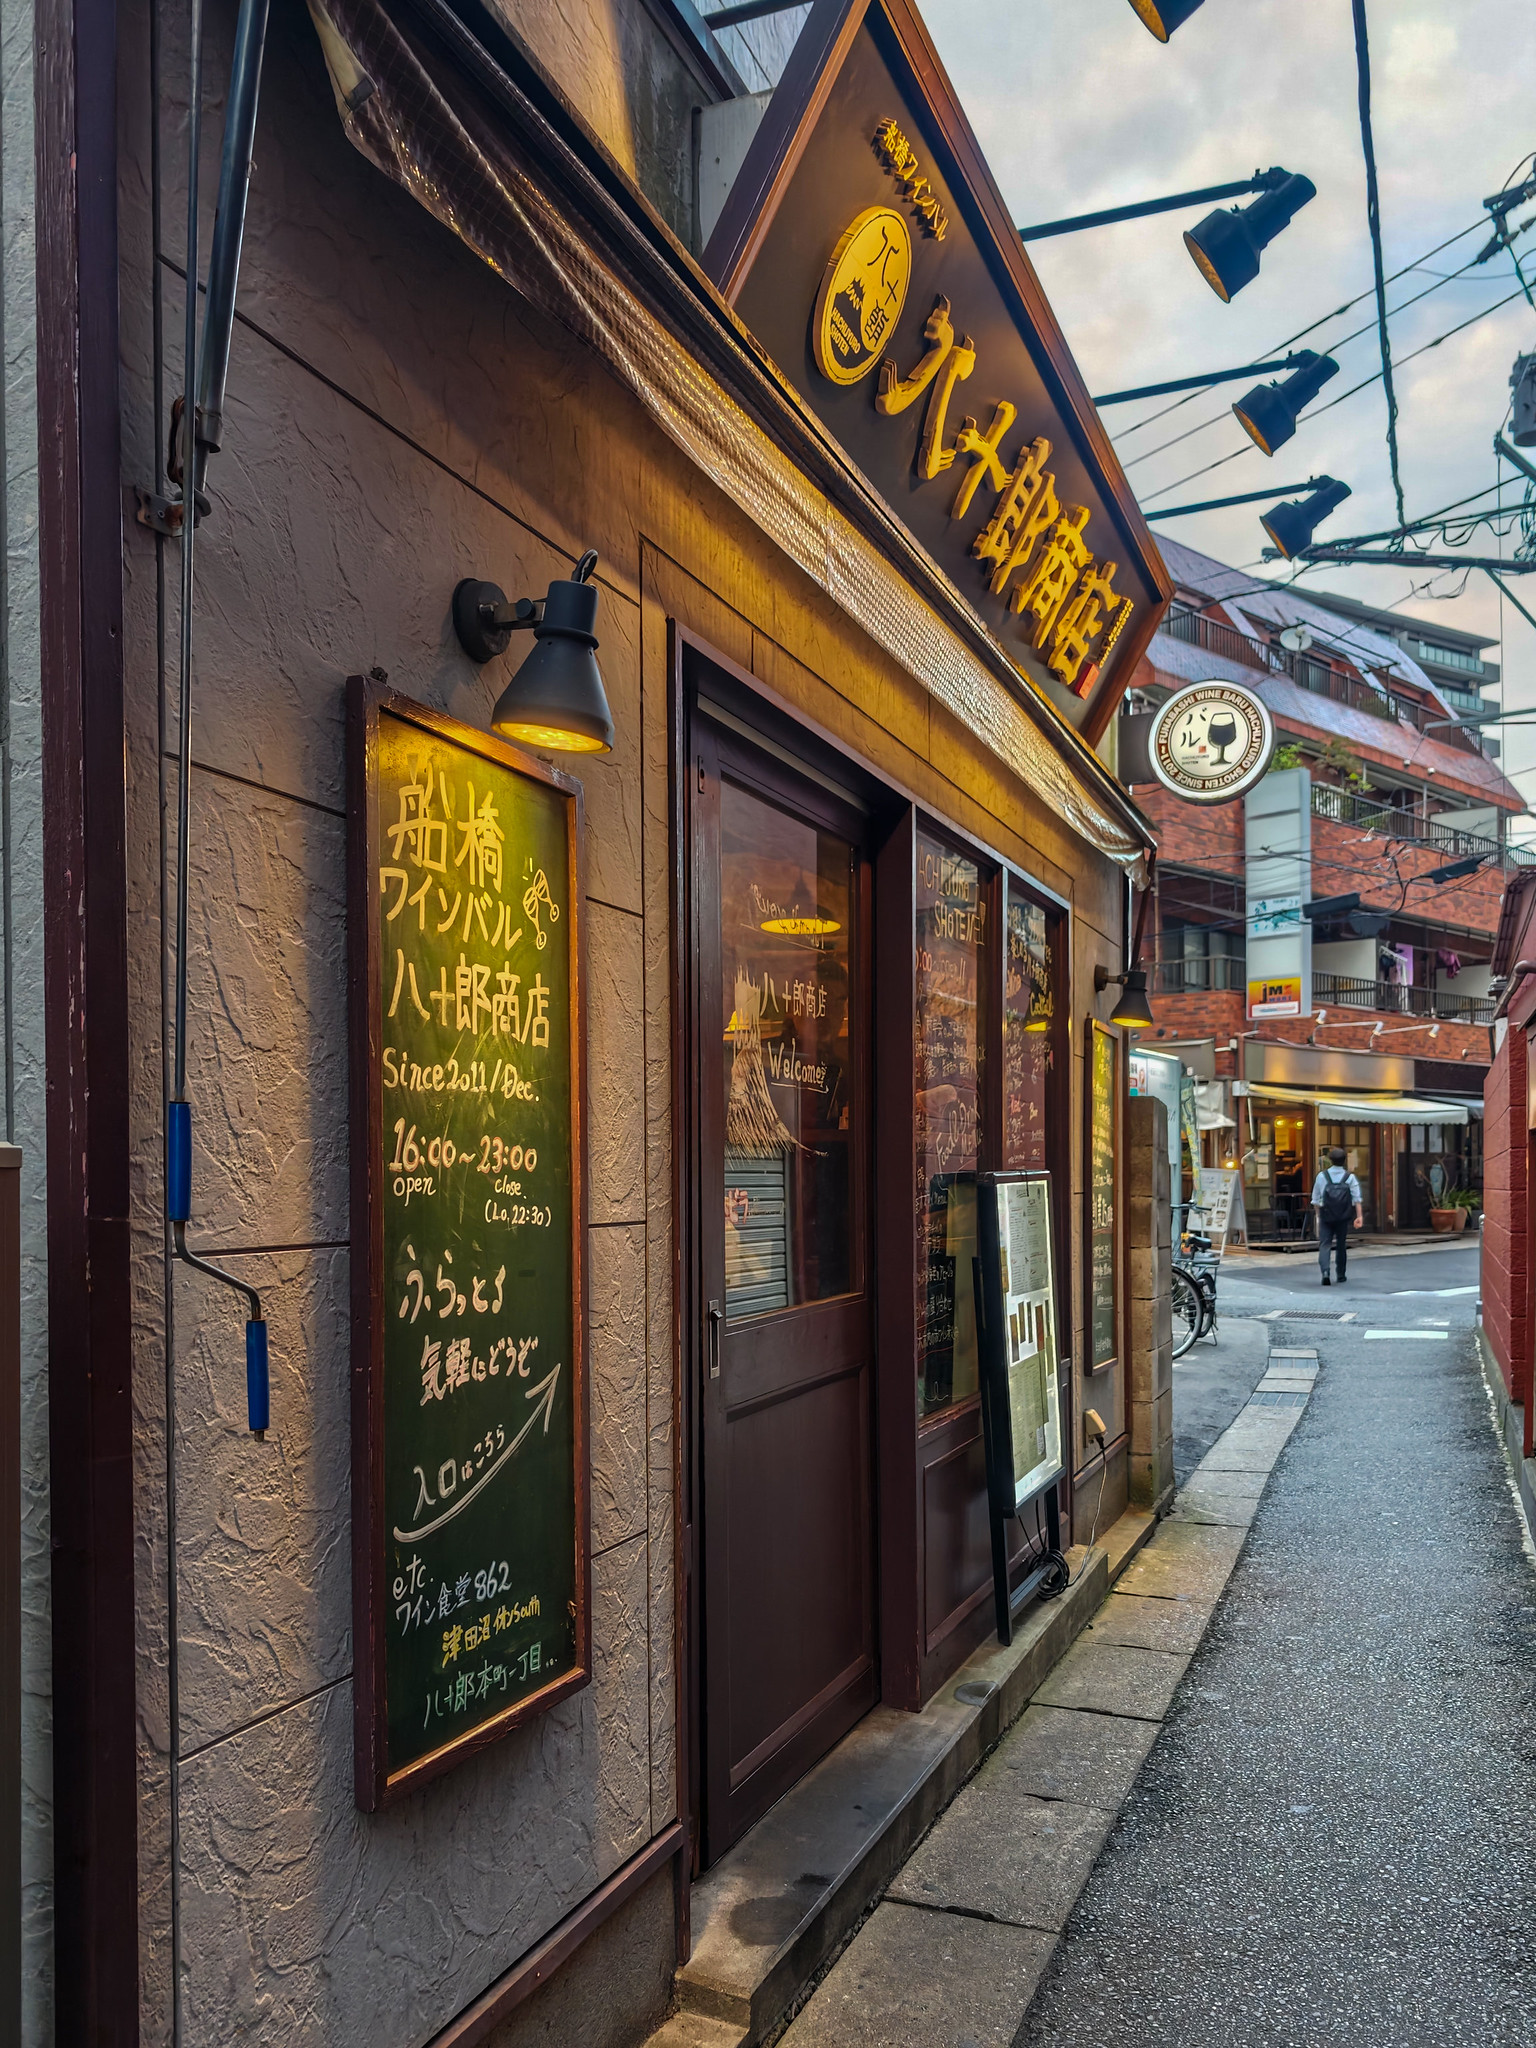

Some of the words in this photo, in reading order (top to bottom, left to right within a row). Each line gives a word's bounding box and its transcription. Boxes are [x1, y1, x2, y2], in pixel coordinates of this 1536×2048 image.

[876, 293, 1119, 686] 八十郎商店
[1195, 689, 1221, 701] WINE
[1222, 690, 1249, 709] BARU
[1158, 696, 1196, 745] FUNABASHI
[1180, 706, 1208, 749] バル
[1175, 771, 1203, 790] SINCE
[1204, 767, 1245, 790] SHOTEN
[387, 761, 505, 894] 船橋
[380, 867, 523, 951] ワインバル
[387, 948, 549, 1048] 八十郎商店
[760, 972, 828, 1019] 八十郎商店
[382, 1047, 445, 1093] Since
[767, 1037, 826, 1086] Welcome
[420, 1335, 539, 1407] 気軽にどうぞ
[412, 1424, 505, 1521] 入口はこちら
[393, 1554, 434, 1601] etc.
